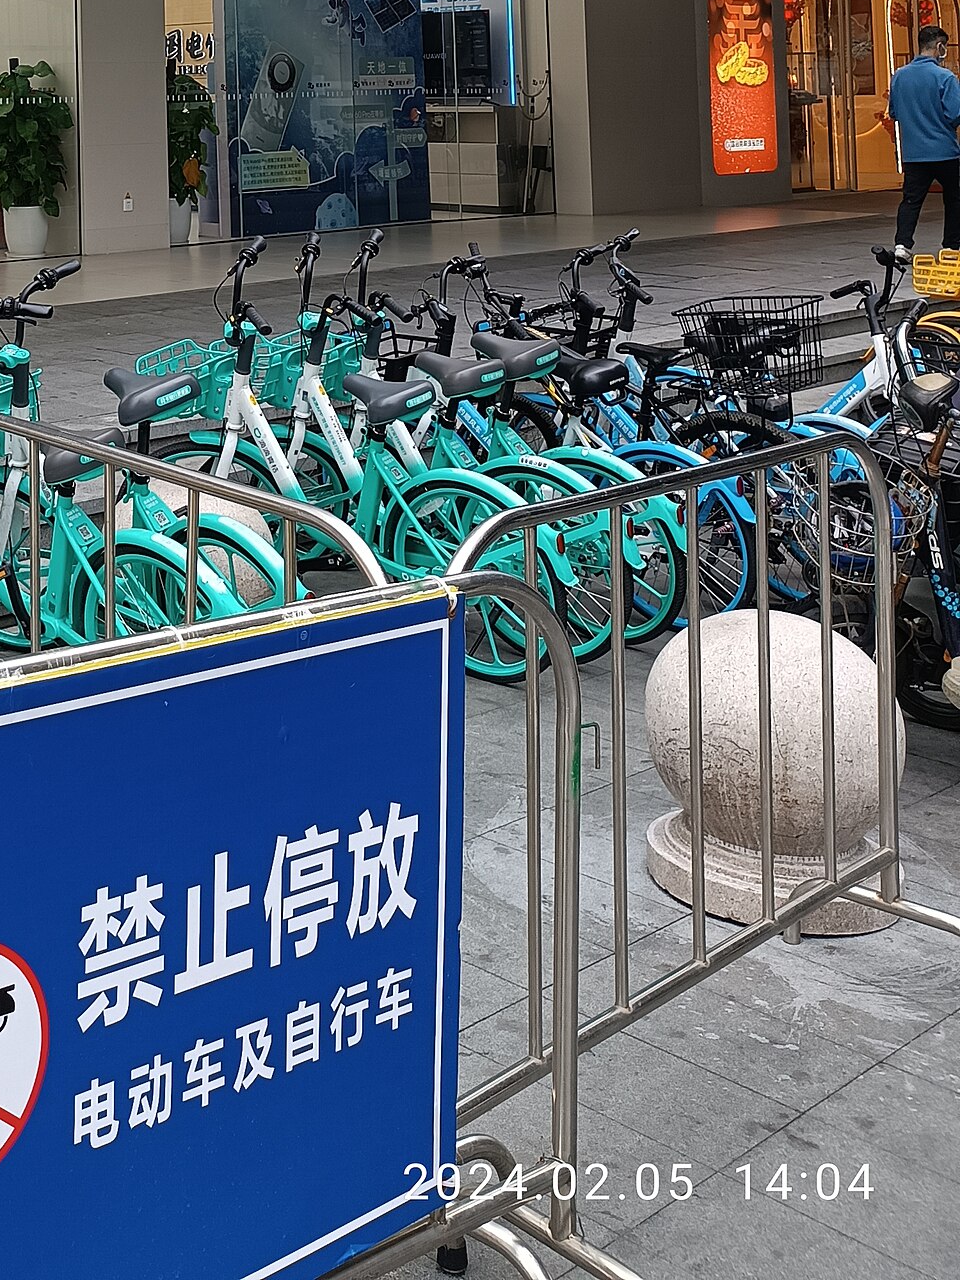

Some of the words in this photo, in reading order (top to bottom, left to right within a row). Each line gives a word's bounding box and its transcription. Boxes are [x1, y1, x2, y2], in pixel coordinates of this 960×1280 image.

[76, 802, 419, 1034] 禁止停放
[73, 967, 415, 1150] 电动车及自行车
